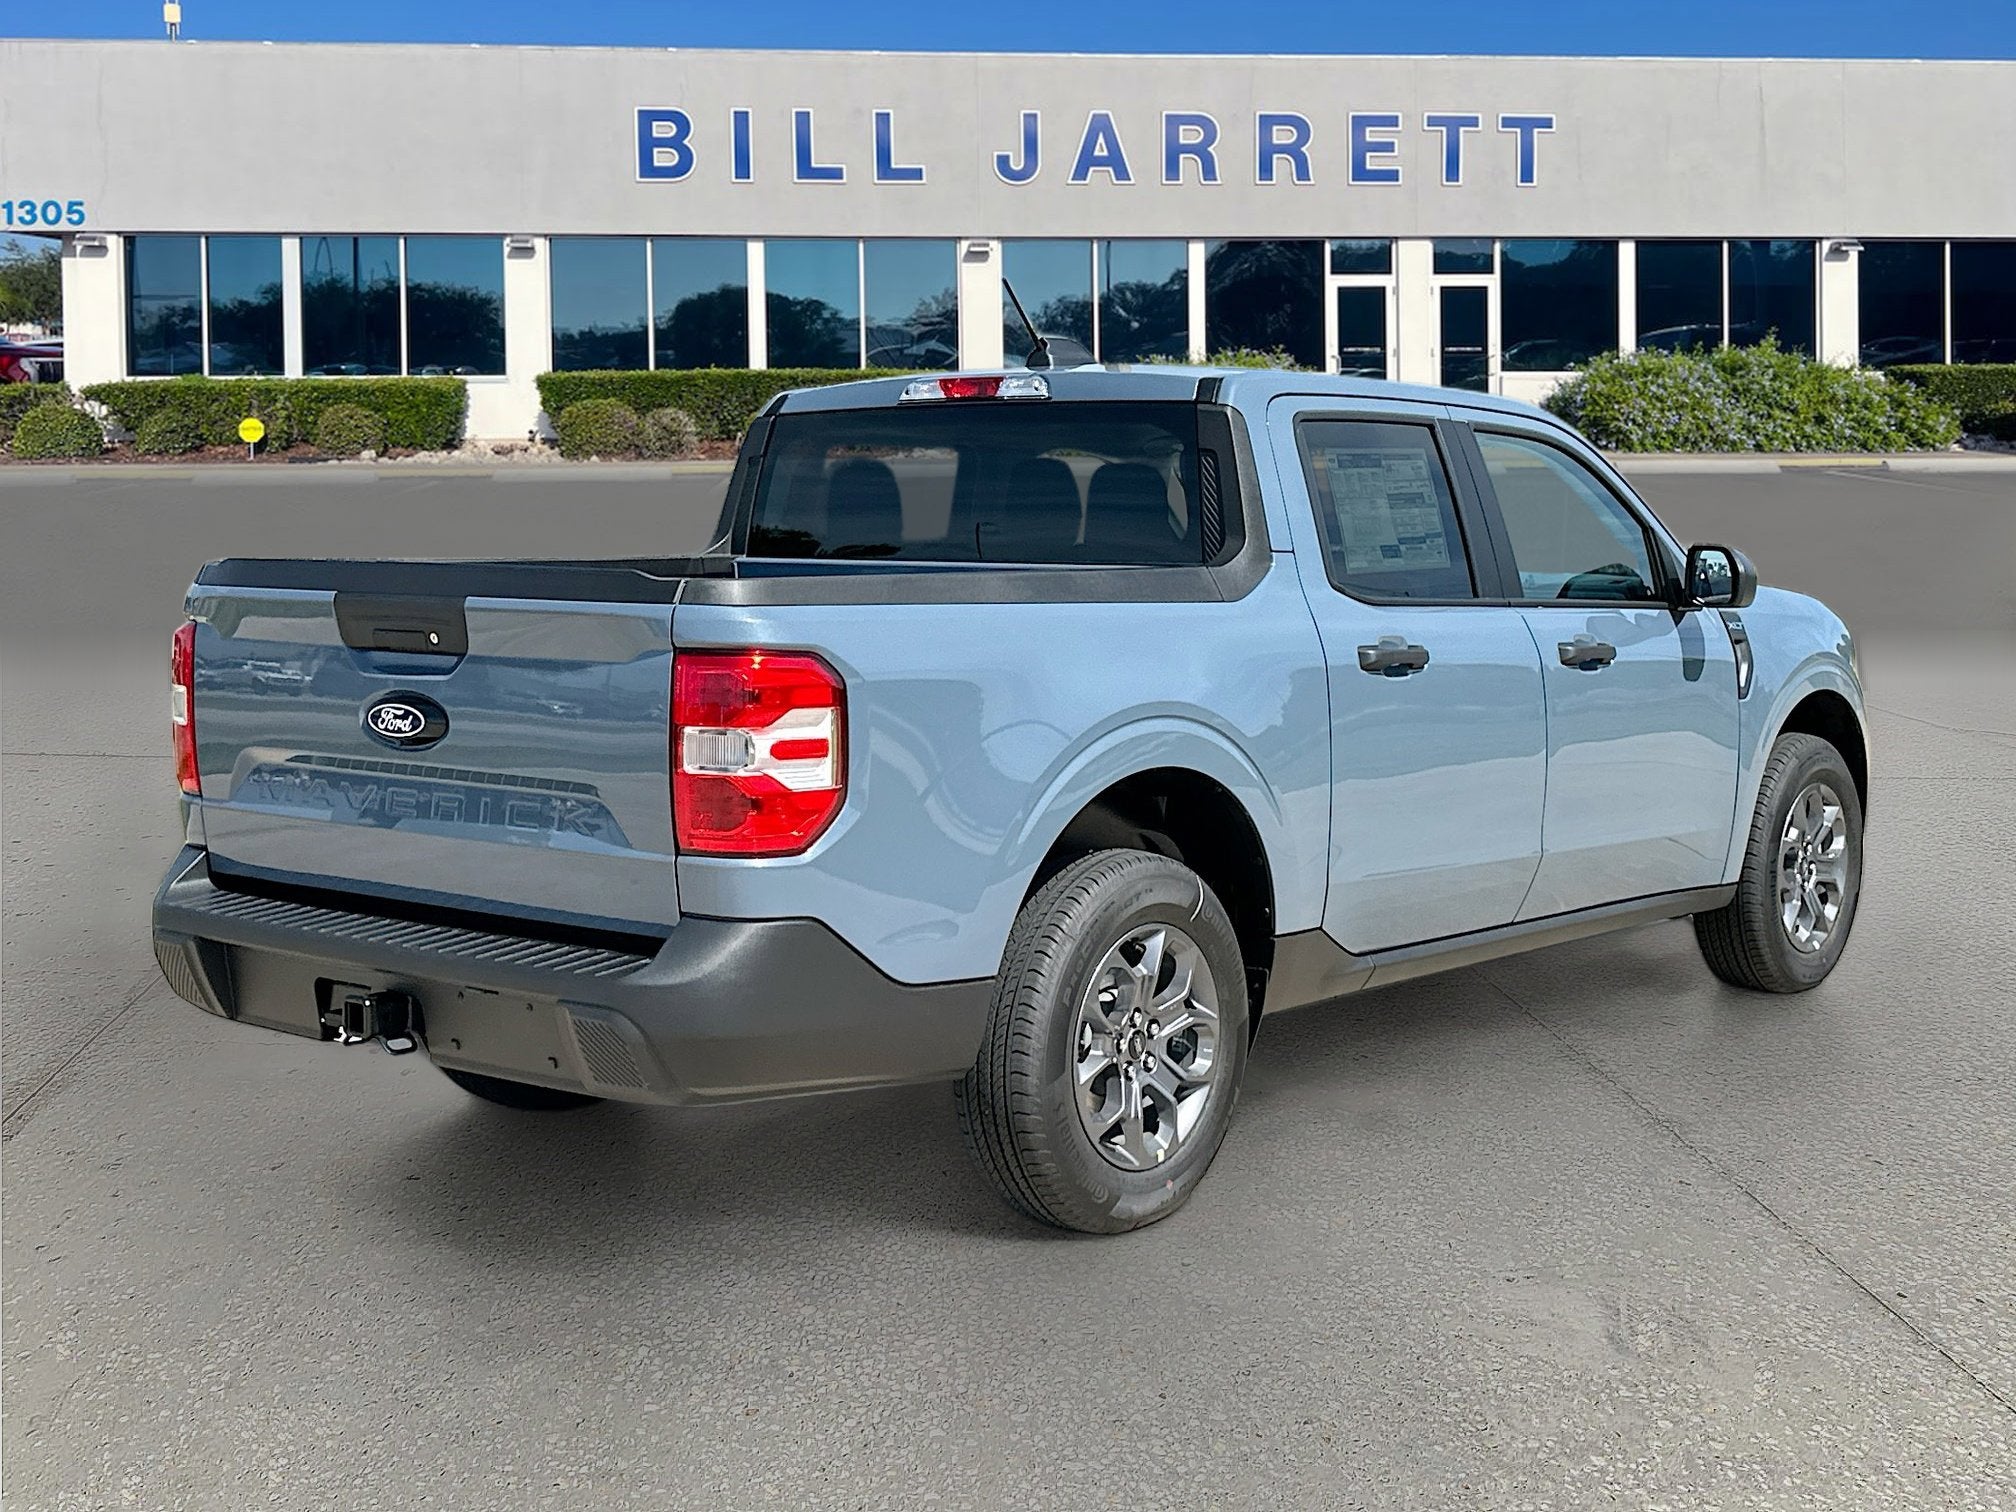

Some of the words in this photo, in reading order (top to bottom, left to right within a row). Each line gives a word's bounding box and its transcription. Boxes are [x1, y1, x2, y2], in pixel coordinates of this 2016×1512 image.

[634, 107, 926, 184] BILL
[993, 110, 1556, 187] JARRETT
[1, 200, 86, 226] 1305
[377, 708, 413, 731] Ford
